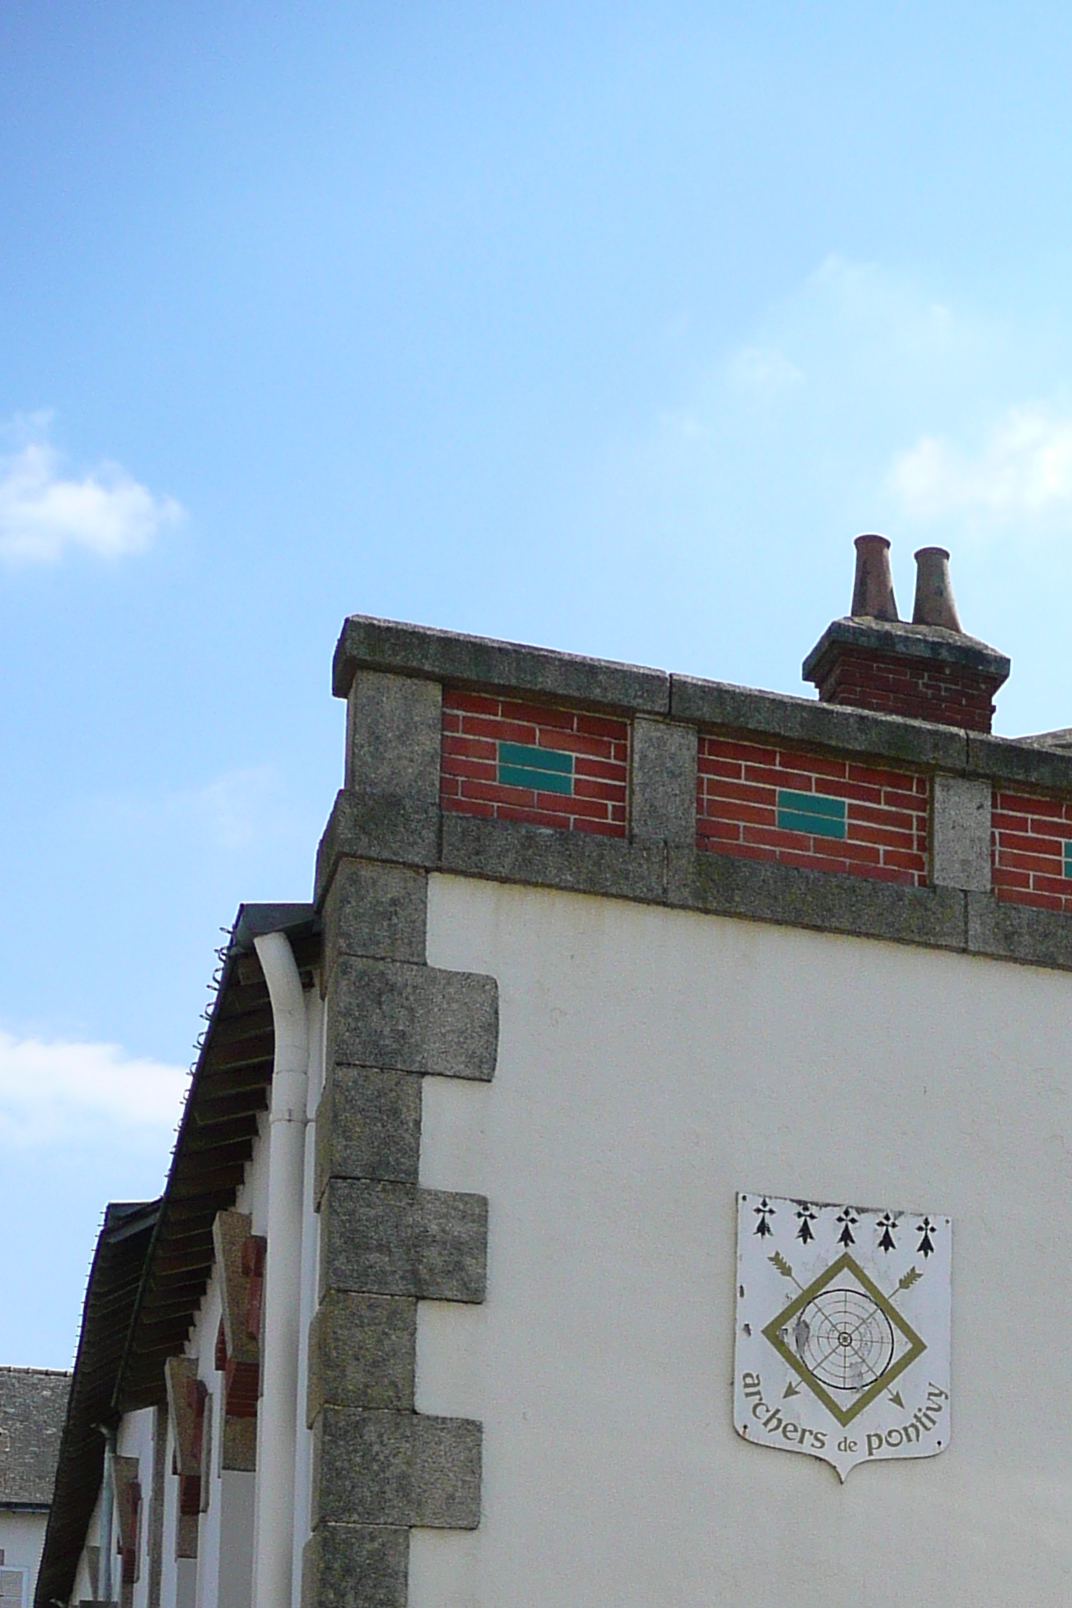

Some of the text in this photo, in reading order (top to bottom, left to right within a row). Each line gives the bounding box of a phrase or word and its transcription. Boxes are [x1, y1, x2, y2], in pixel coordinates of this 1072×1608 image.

[742, 1372, 949, 1456] archers de pontivy
